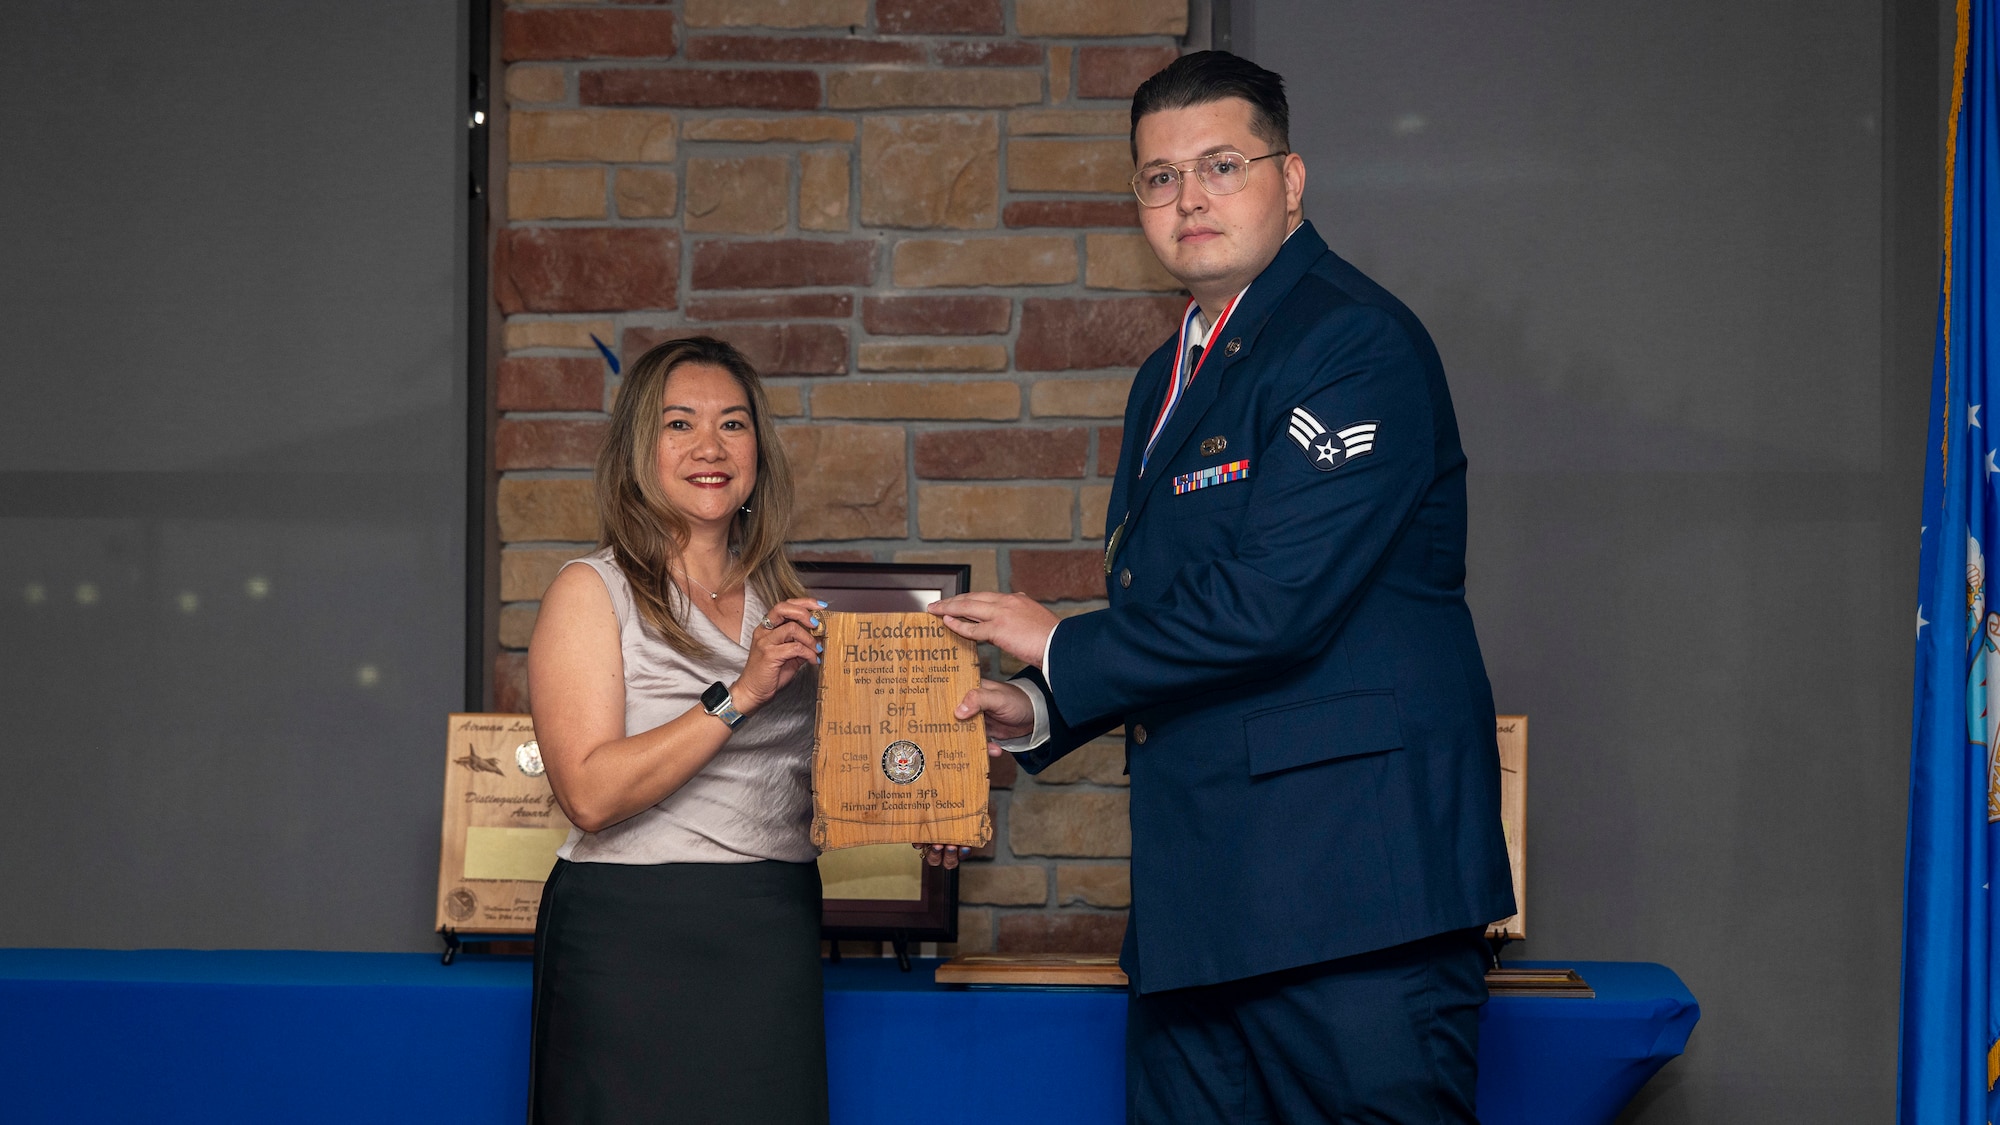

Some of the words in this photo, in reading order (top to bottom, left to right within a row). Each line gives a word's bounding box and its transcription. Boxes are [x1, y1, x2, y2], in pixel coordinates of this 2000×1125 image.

[857, 621, 945, 640] Academic
[844, 644, 958, 663] Achievement
[843, 667, 850, 675] is
[855, 666, 894, 675] presented
[912, 665, 924, 673] the
[928, 665, 959, 673] student
[854, 677, 871, 685] who
[875, 676, 907, 684] denotes
[911, 675, 949, 684] excellence
[900, 687, 929, 695] scholar
[887, 702, 916, 716] SrA
[458, 721, 503, 732] Airman
[826, 721, 871, 735] Aidan
[879, 720, 898, 734] R.
[907, 720, 977, 734] Simmons
[842, 752, 868, 761] Class
[933, 761, 970, 772] Avenger
[465, 792, 543, 806] Distinguished
[868, 790, 912, 799] Holloman
[916, 789, 938, 799] AFB
[841, 802, 878, 812] Airman
[881, 801, 931, 811] Leadership
[935, 800, 965, 810] School
[510, 807, 551, 818] Award
